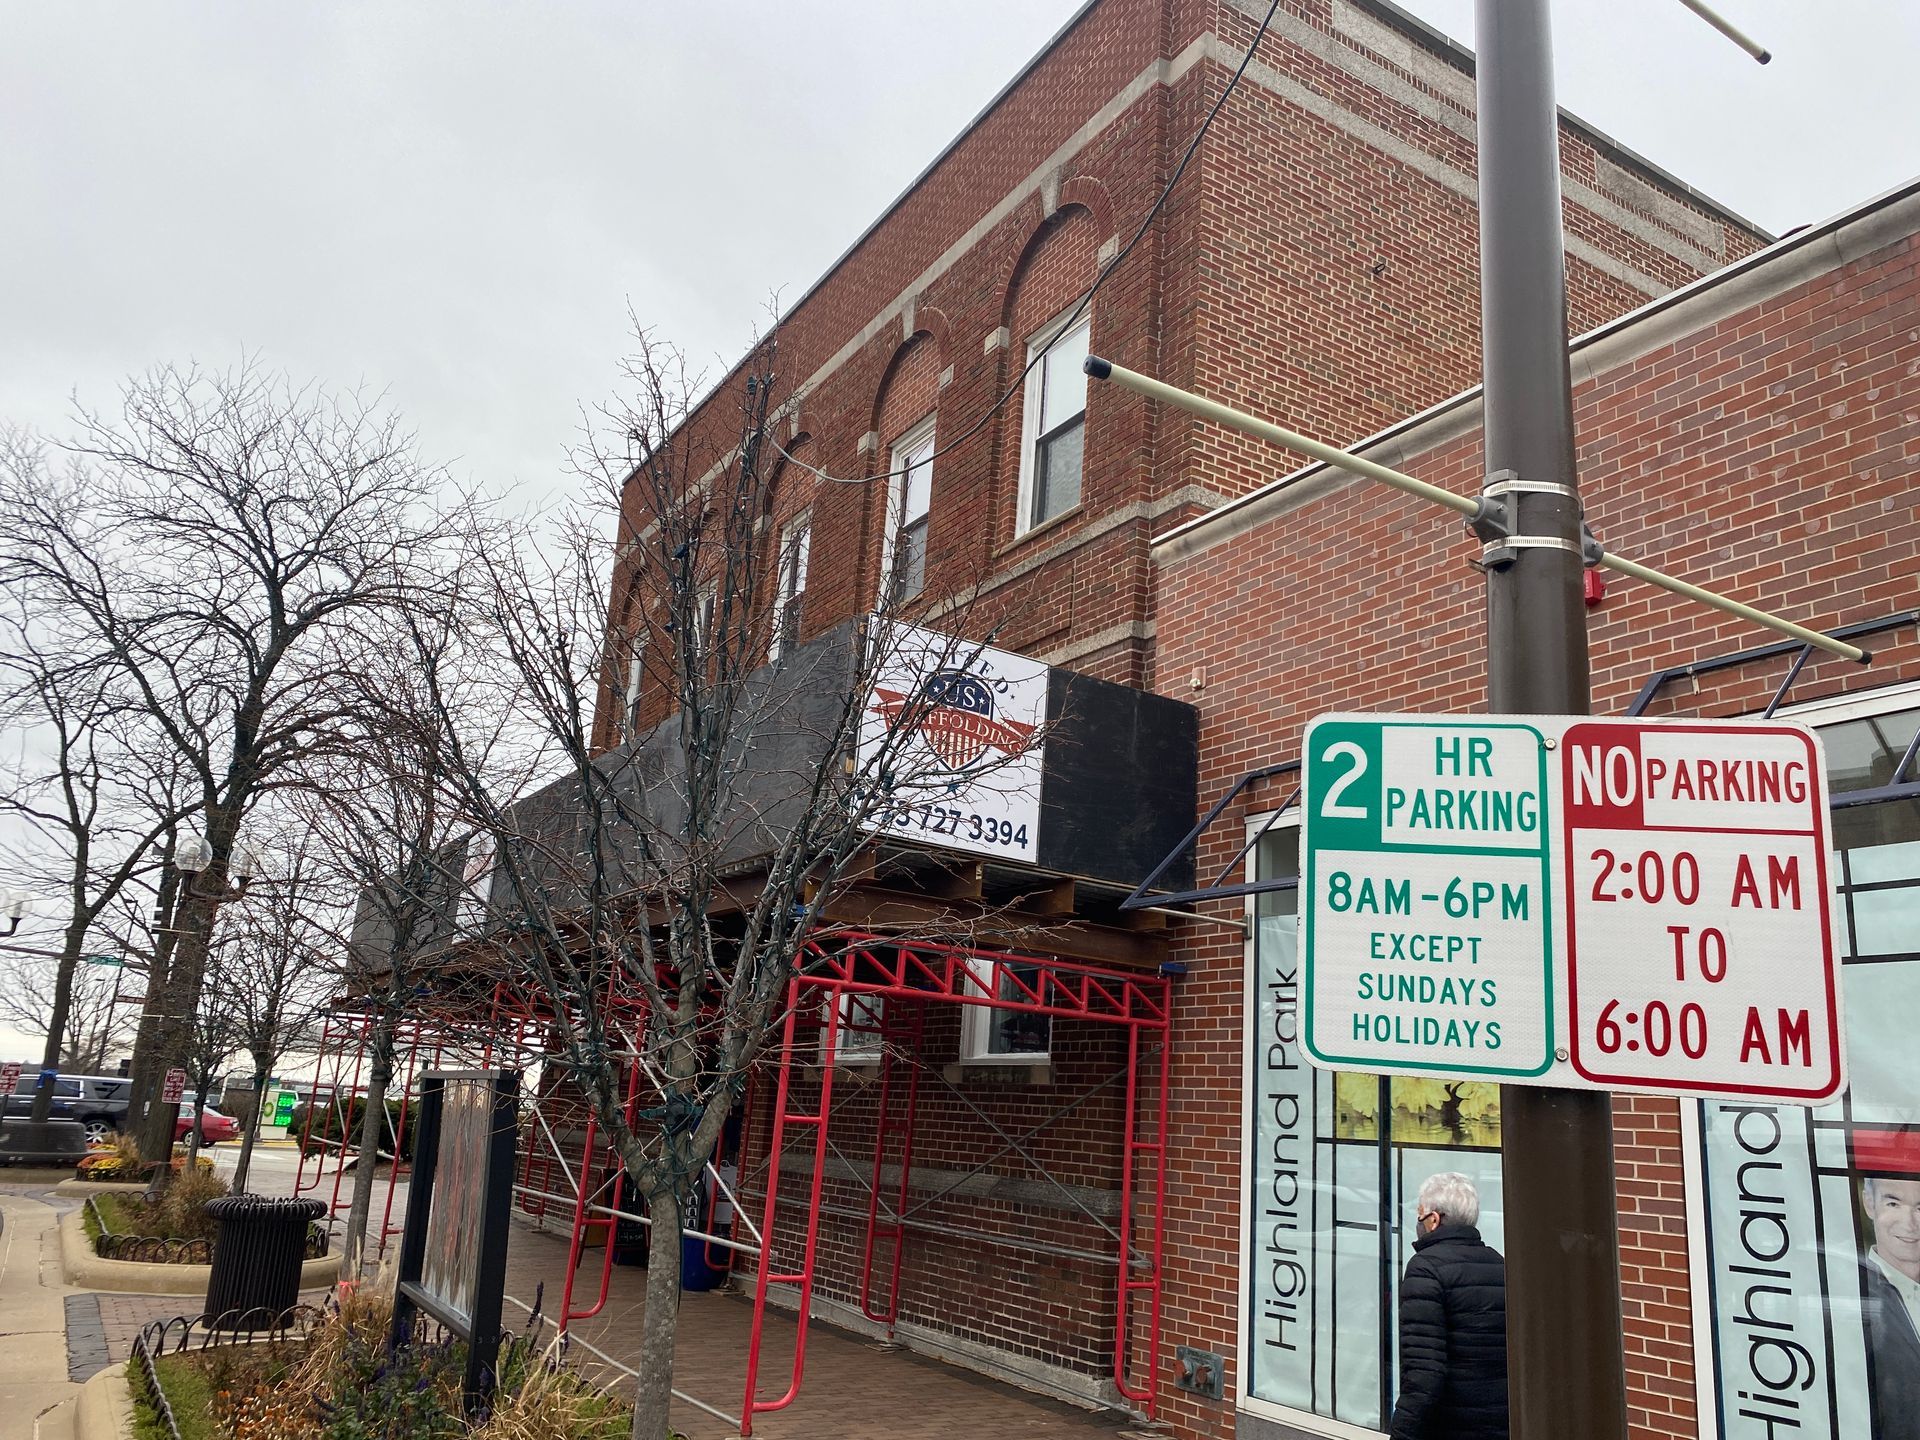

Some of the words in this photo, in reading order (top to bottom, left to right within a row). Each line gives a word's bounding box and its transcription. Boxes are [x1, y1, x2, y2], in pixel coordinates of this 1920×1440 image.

[945, 680, 977, 708] US
[886, 709, 1024, 753] SFFOLDING
[1321, 742, 1367, 818] 2
[1435, 736, 1492, 777] HR
[1572, 745, 1636, 806] NO
[1647, 759, 1805, 803] PARKING
[917, 803, 962, 836] 727
[968, 813, 1029, 850] 3394
[1386, 787, 1537, 832] PARKING
[1592, 849, 1699, 905] 2:00
[1732, 854, 1801, 909] AM
[1370, 932, 1481, 963] EXCEPT
[1667, 926, 1726, 982] TO
[1358, 973, 1496, 1007] SUNDAYS
[1268, 968, 1298, 1069] Park
[1353, 1014, 1501, 1050] HOLIDAYS
[1597, 1000, 1707, 1059] 6:00
[1740, 1008, 1811, 1067] AM
[1265, 1093, 1306, 1351] Highland
